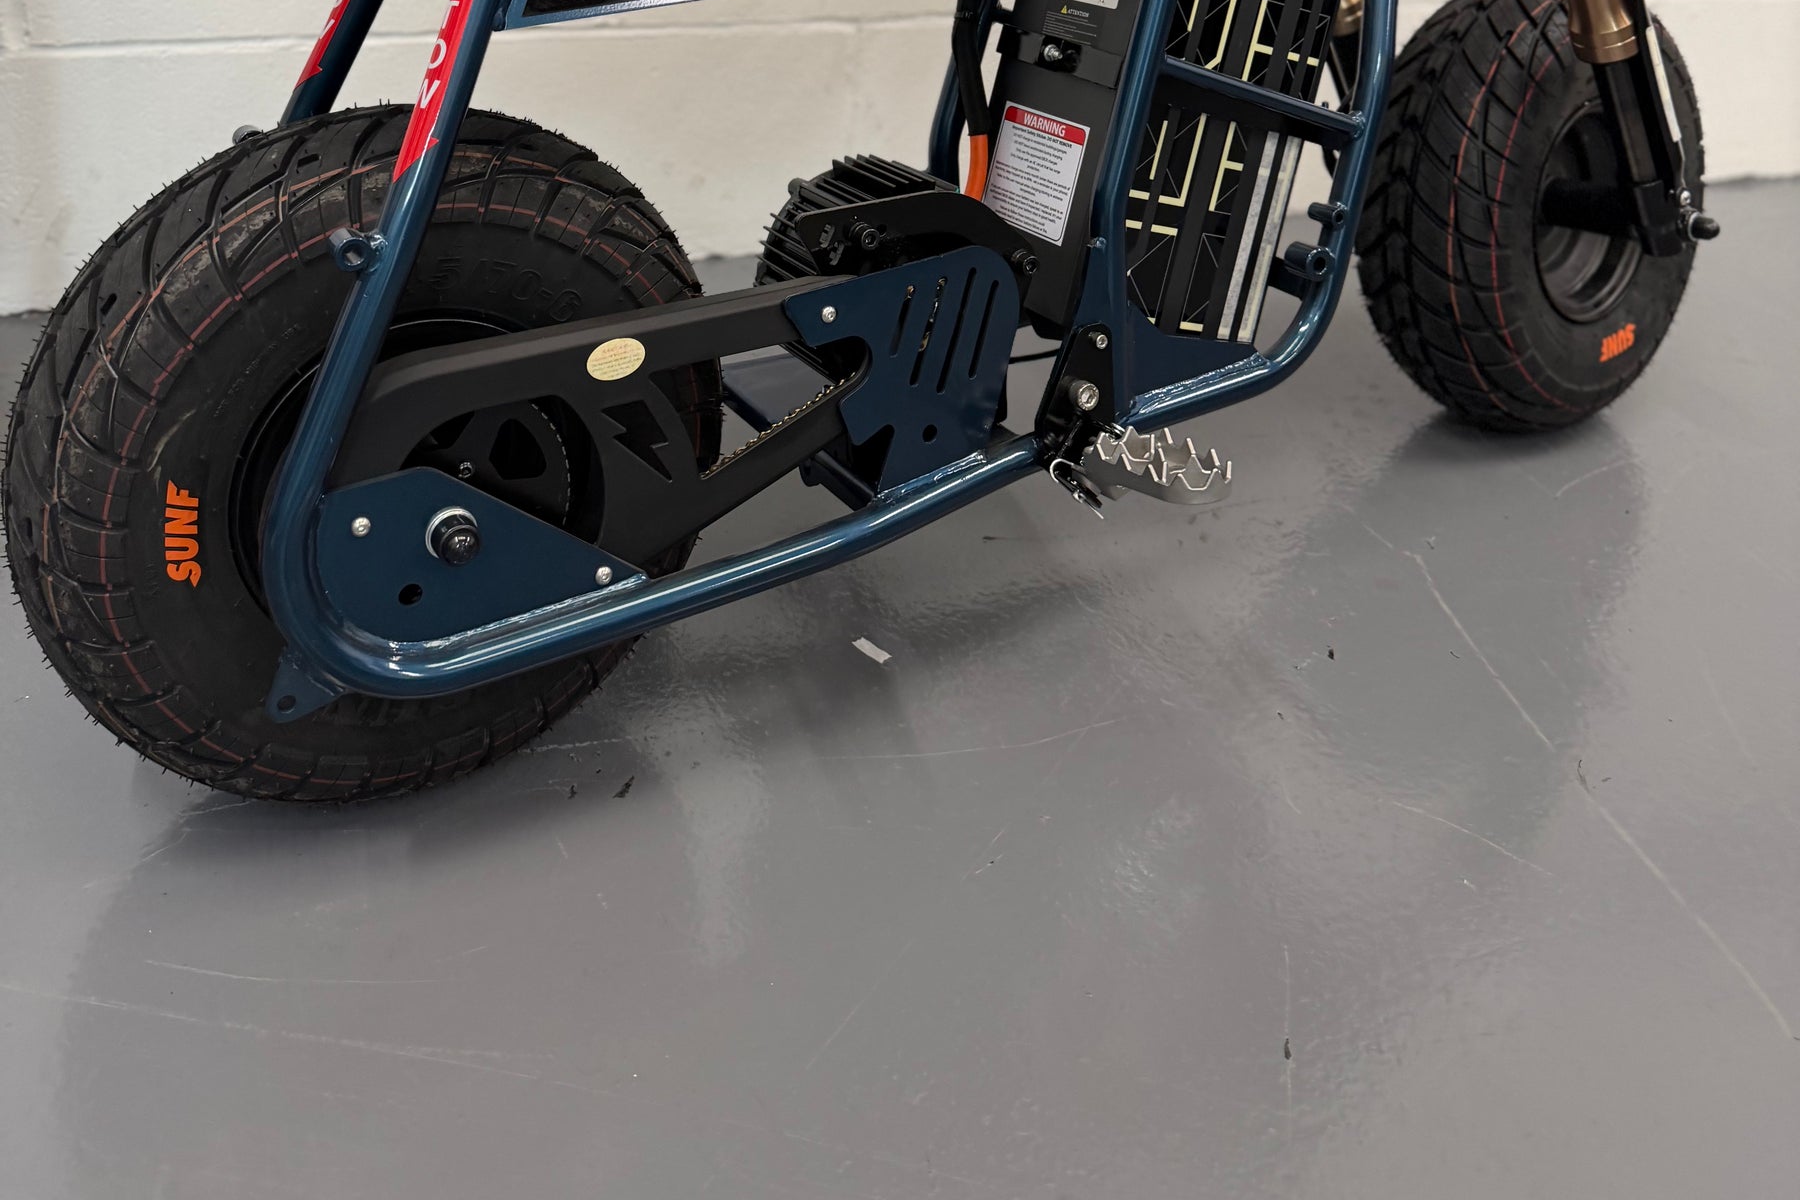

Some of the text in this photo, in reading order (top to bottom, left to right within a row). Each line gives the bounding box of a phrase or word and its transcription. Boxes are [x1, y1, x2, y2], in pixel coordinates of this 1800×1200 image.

[1024, 112, 1066, 137] WARNING
[1600, 323, 1636, 362] SUNF
[164, 480, 201, 587] SUNF
